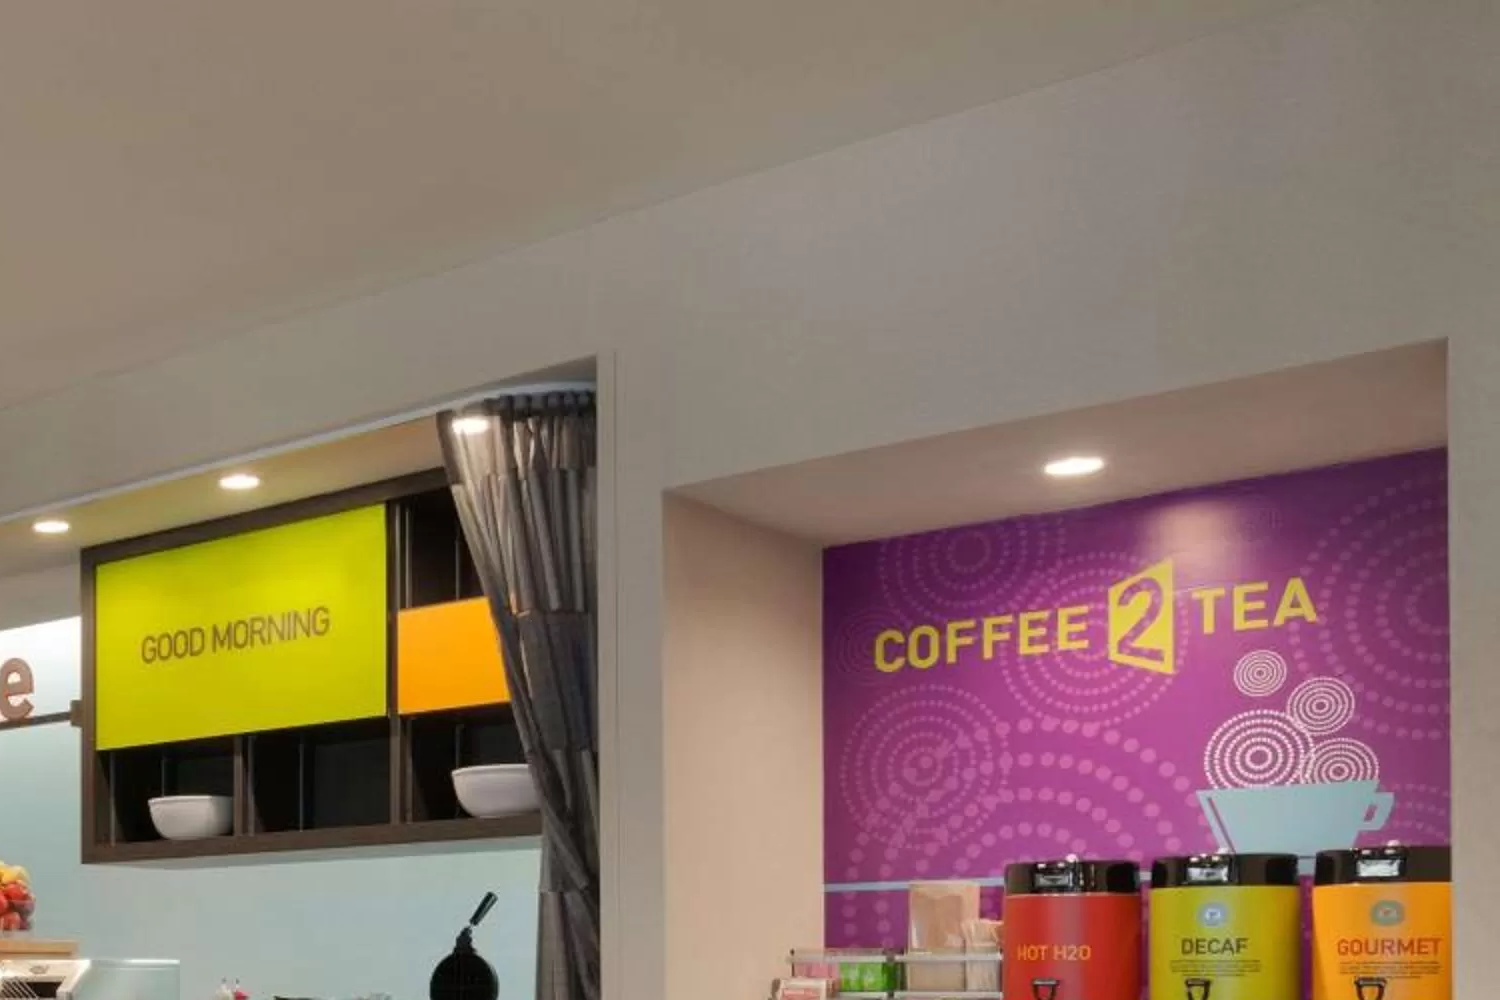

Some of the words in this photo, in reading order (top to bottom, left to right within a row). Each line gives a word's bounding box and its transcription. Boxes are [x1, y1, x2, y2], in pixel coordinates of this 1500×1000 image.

[874, 604, 1090, 673] COFFEE
[1114, 575, 1166, 668] 2
[1194, 576, 1318, 635] TEA
[141, 627, 206, 665] GOOD
[211, 606, 331, 654] MORNING
[1016, 943, 1049, 961] HOT
[1180, 937, 1250, 956] DECAF
[1336, 936, 1443, 957] GOURMET
